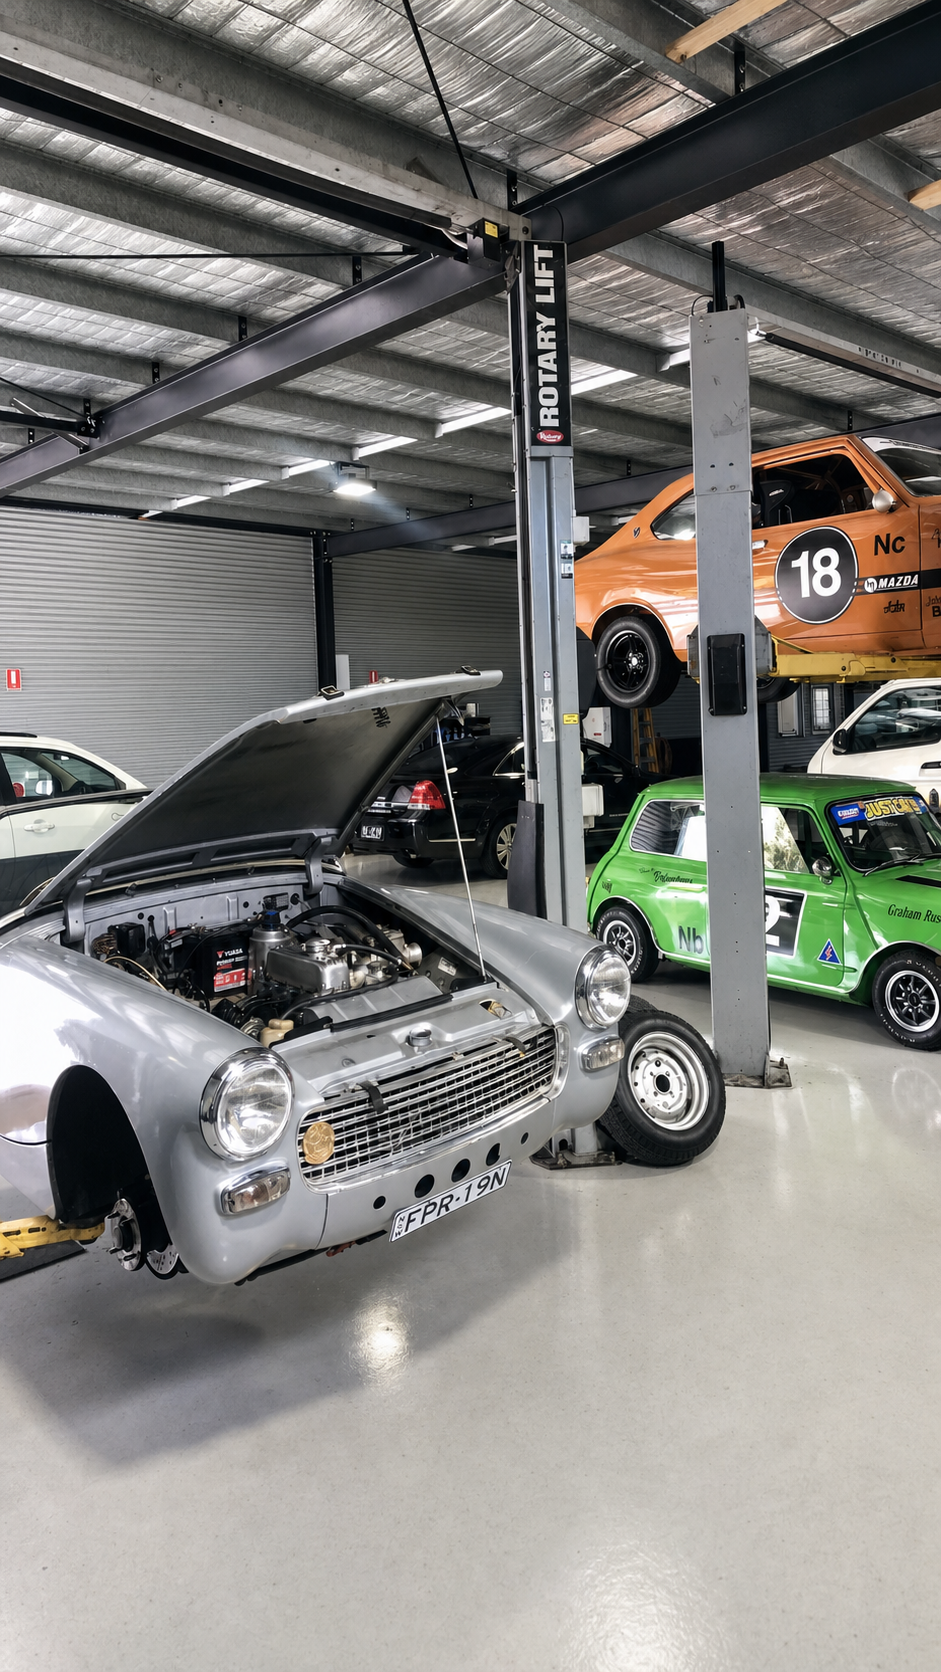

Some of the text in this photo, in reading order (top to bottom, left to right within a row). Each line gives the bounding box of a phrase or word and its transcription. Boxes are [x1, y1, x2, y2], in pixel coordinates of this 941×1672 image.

[533, 244, 560, 427] ROTARY LIFT
[874, 533, 906, 556] Nc
[791, 547, 842, 599] 18
[878, 574, 919, 589] MAZDA
[865, 801, 893, 819] JUST
[887, 903, 922, 921] Graham
[678, 925, 704, 954] Nb
